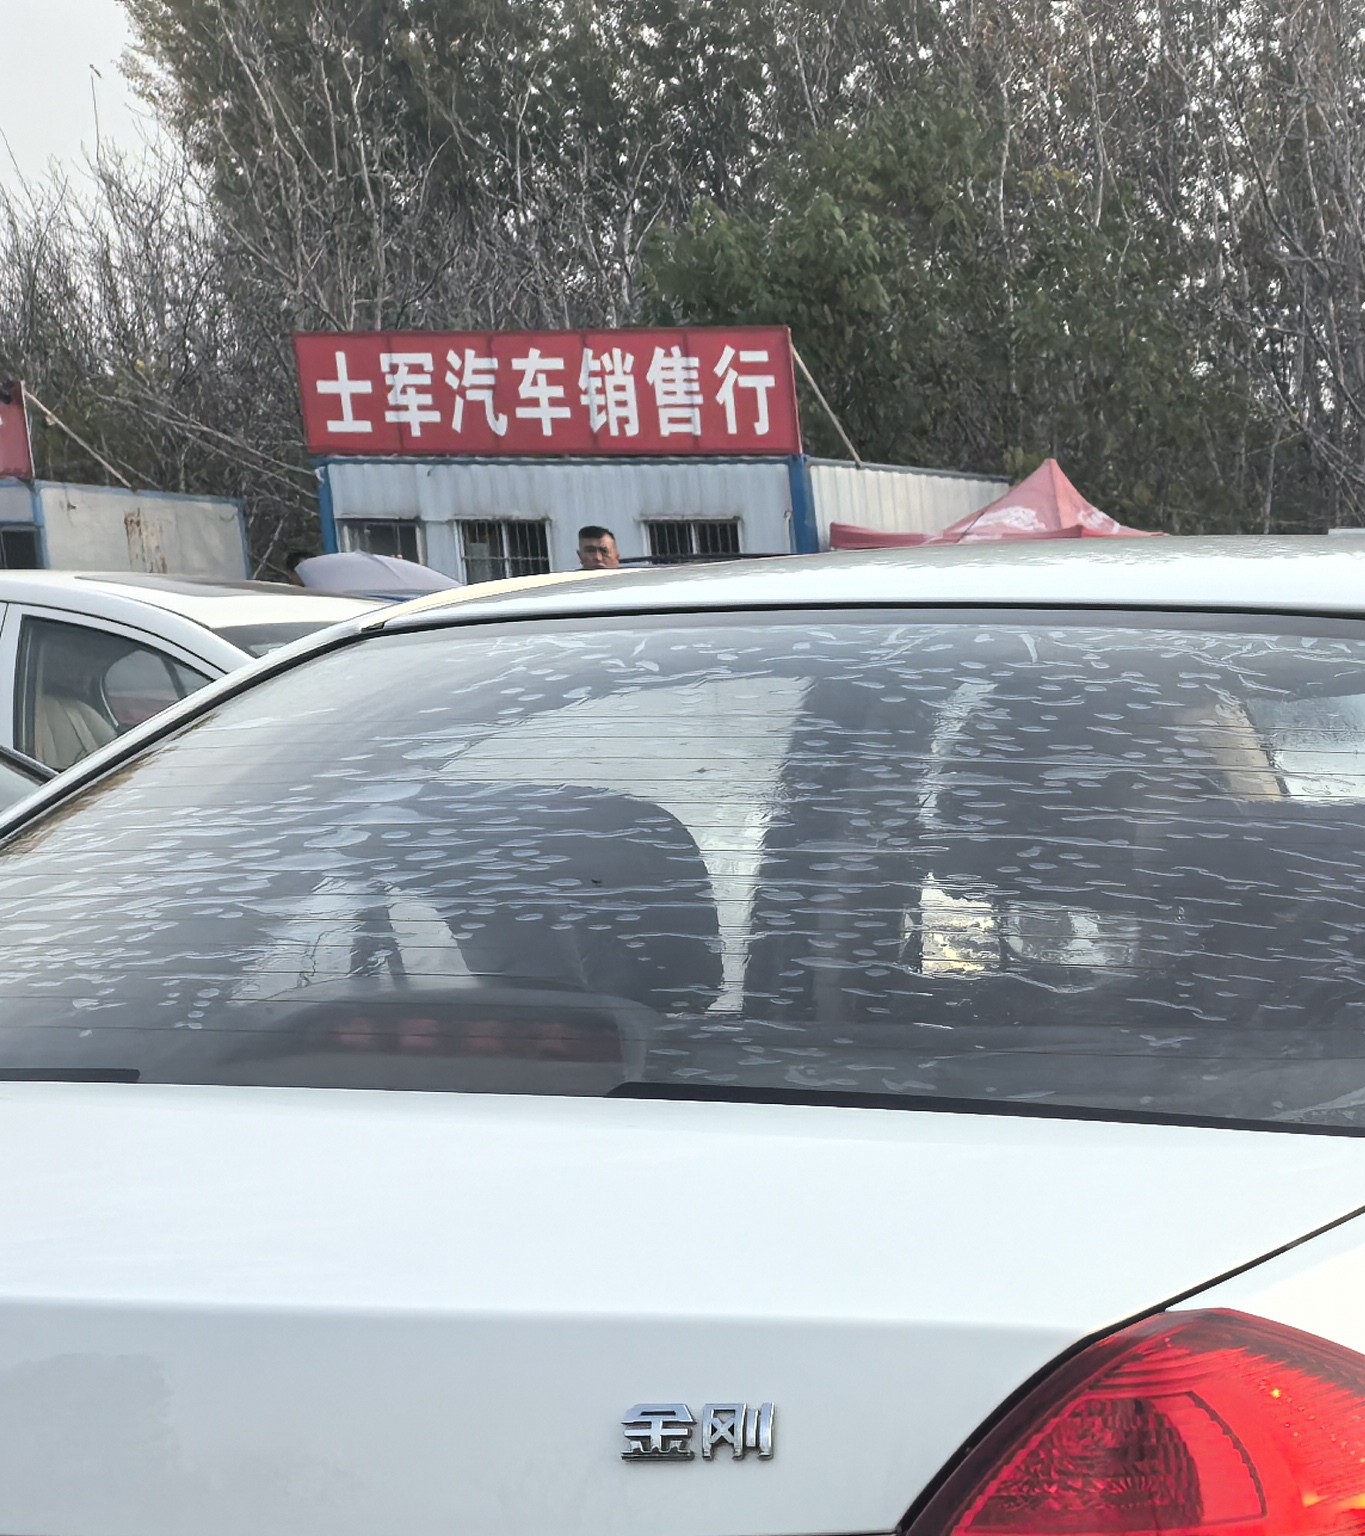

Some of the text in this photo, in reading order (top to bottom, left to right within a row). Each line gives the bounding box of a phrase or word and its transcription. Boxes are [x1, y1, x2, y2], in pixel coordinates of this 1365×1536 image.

[316, 345, 776, 438] 士军汽车销售行
[620, 1402, 776, 1462] 金刚
